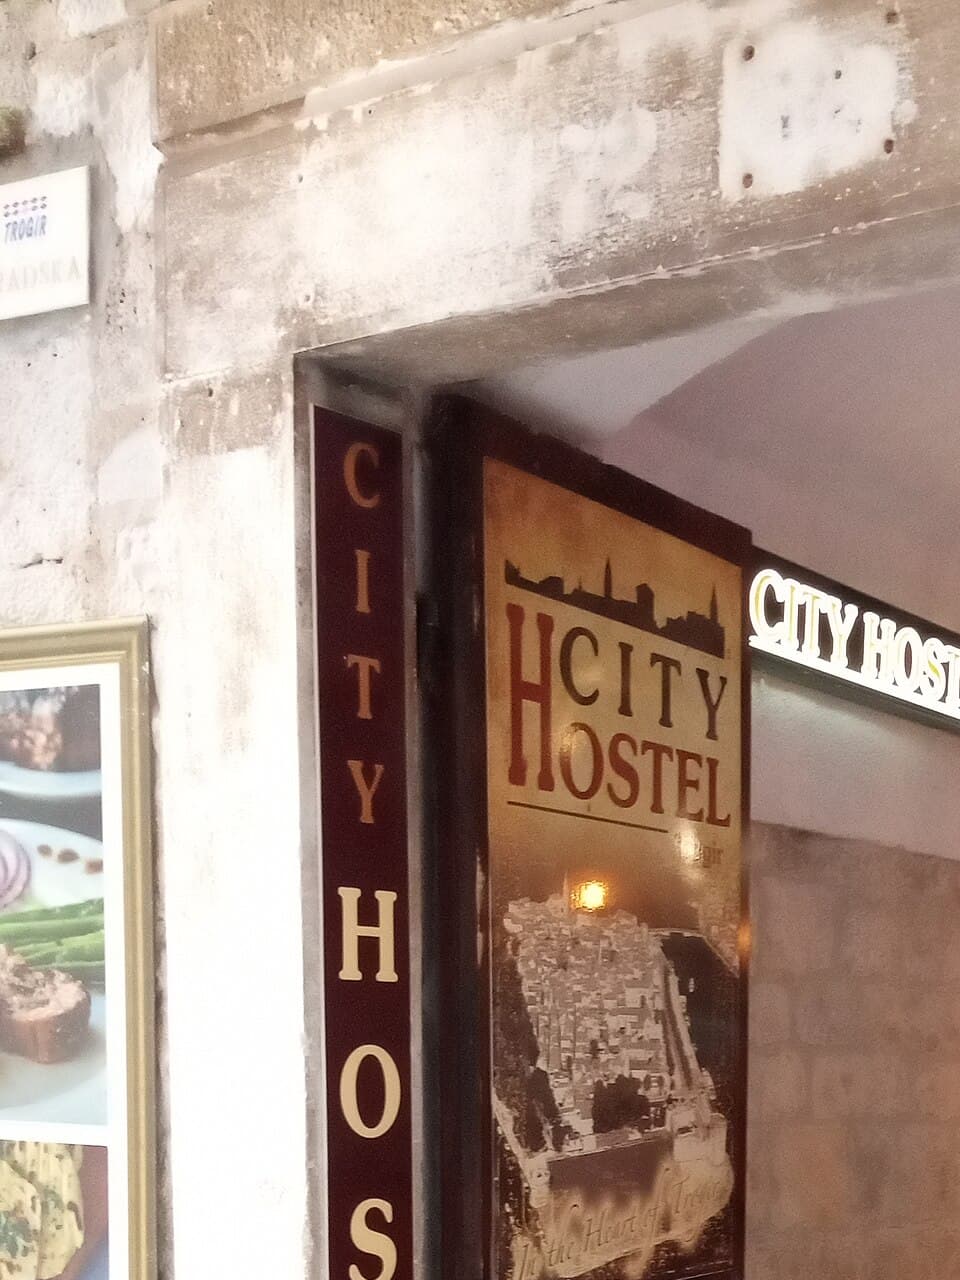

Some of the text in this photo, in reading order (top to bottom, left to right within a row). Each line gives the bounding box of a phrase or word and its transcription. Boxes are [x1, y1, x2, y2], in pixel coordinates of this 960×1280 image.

[0, 256, 80, 292] ADSKA
[4, 215, 47, 244] TROGIR
[343, 442, 384, 824] CITY
[749, 569, 861, 668] CITY
[506, 602, 730, 827] HOSTEL
[559, 625, 727, 740] CITY
